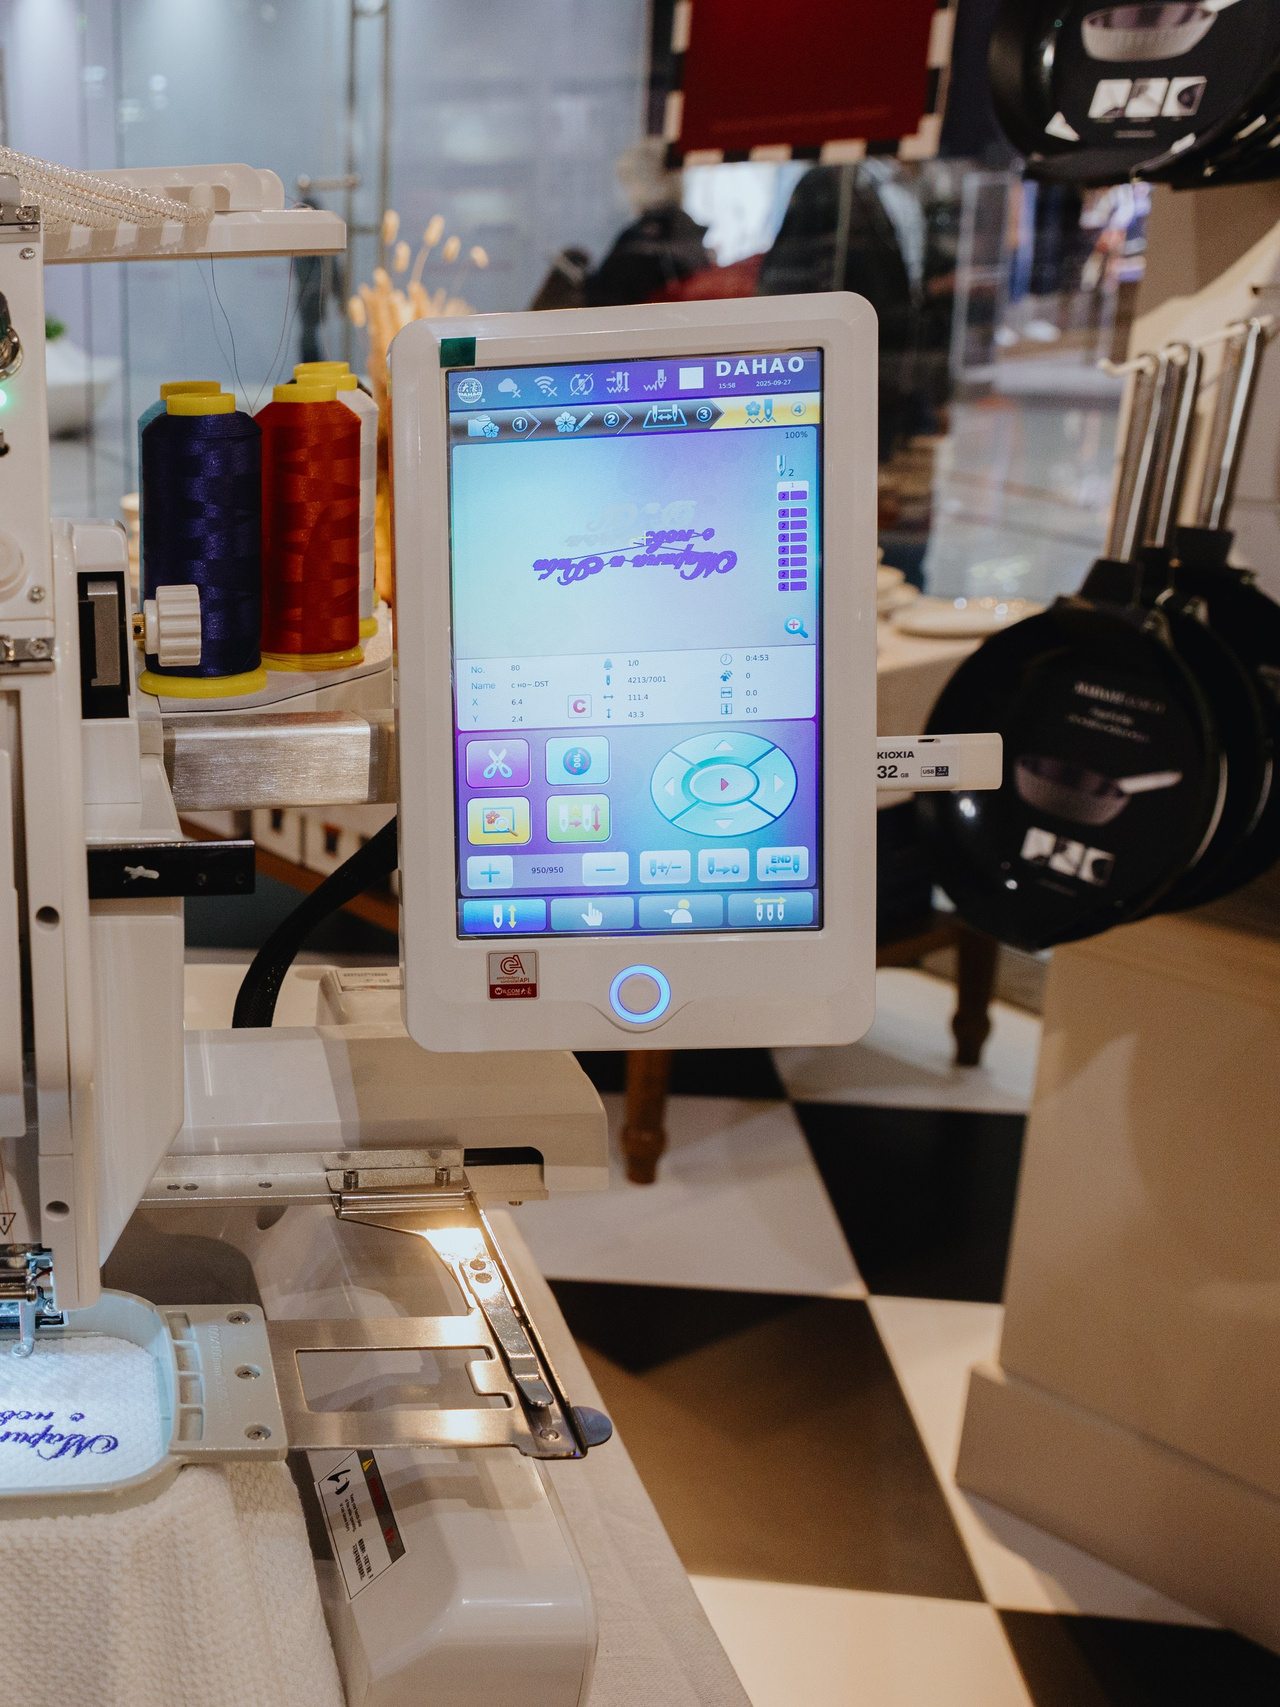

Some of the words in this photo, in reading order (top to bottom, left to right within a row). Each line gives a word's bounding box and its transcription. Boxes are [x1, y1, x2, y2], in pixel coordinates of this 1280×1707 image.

[716, 356, 804, 376] DAHAO
[756, 379, 791, 387] 2025-09-27
[788, 468, 794, 476] 2
[746, 654, 769, 662] 0:4:53
[628, 676, 666, 684] 4213/7001
[573, 699, 586, 714] C
[877, 751, 914, 759] KIOXIA
[877, 765, 898, 778] 32
[770, 855, 791, 864] END
[531, 866, 564, 874] 950/950
[495, 987, 520, 995] WILCOM
